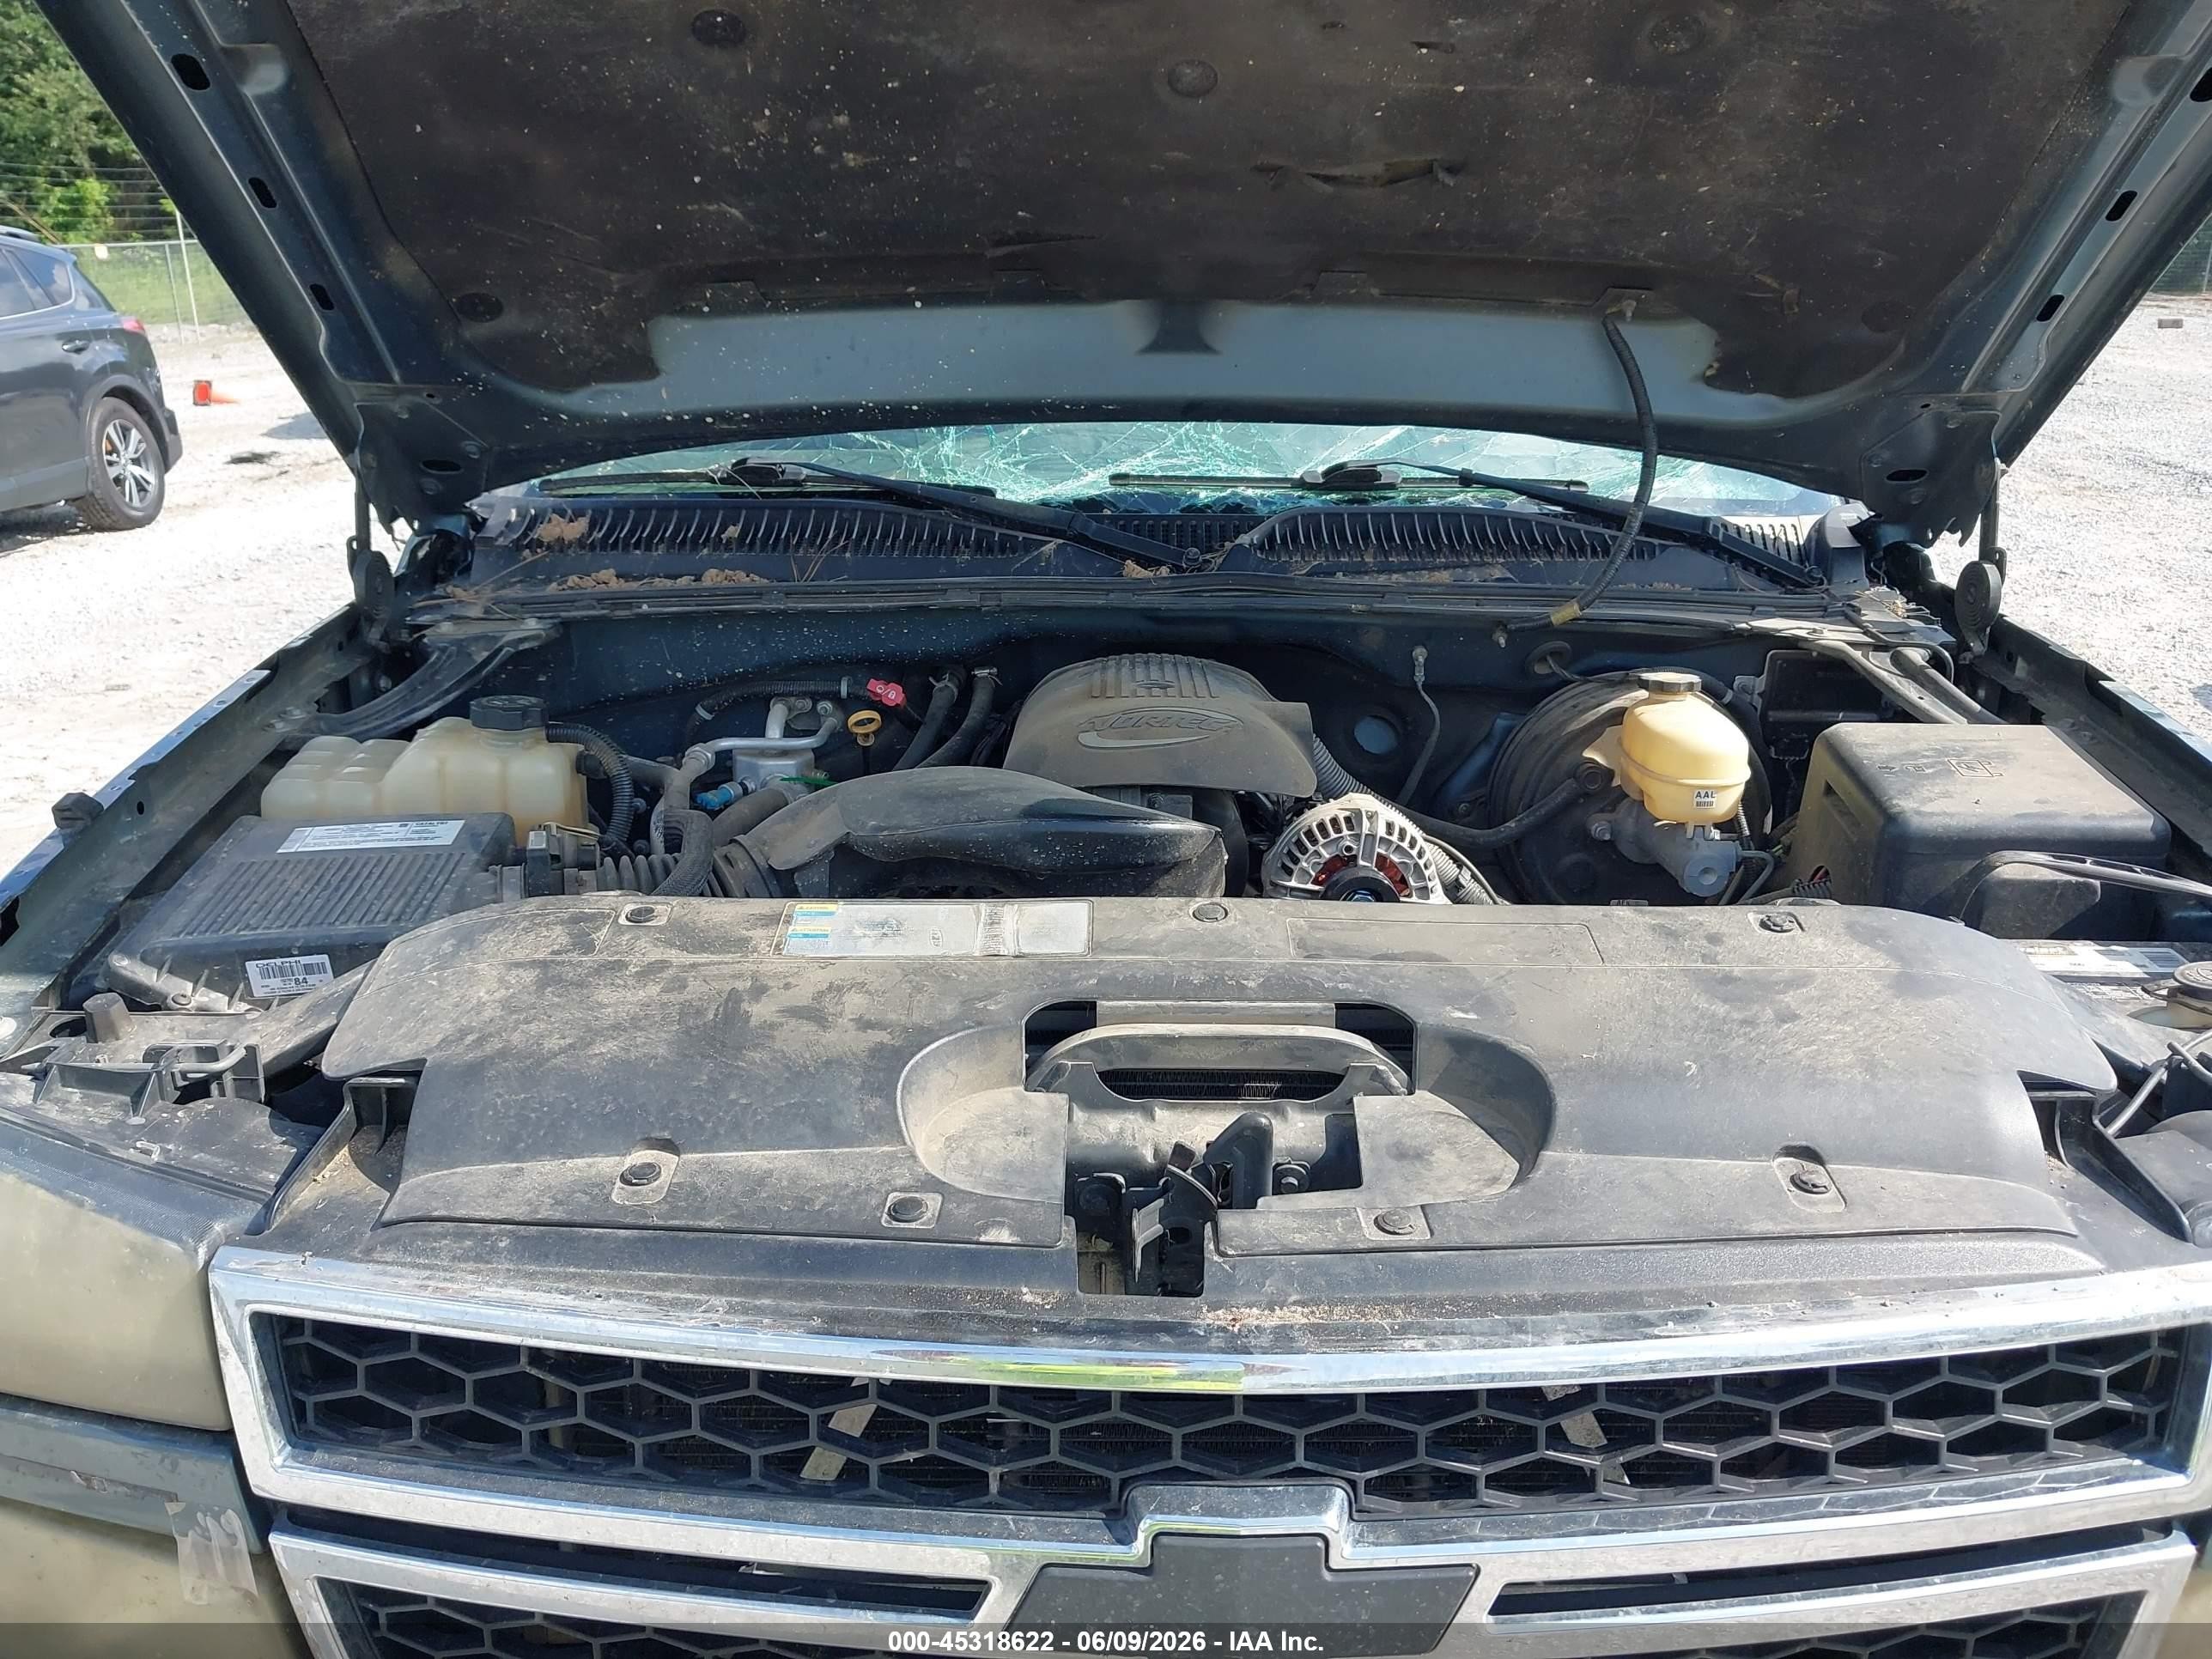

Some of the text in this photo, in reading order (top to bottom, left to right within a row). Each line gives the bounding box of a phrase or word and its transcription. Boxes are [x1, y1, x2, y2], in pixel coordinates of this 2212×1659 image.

[1694, 790, 1717, 799] AAL
[255, 959, 301, 969] DELPHI
[294, 976, 309, 986] 84
